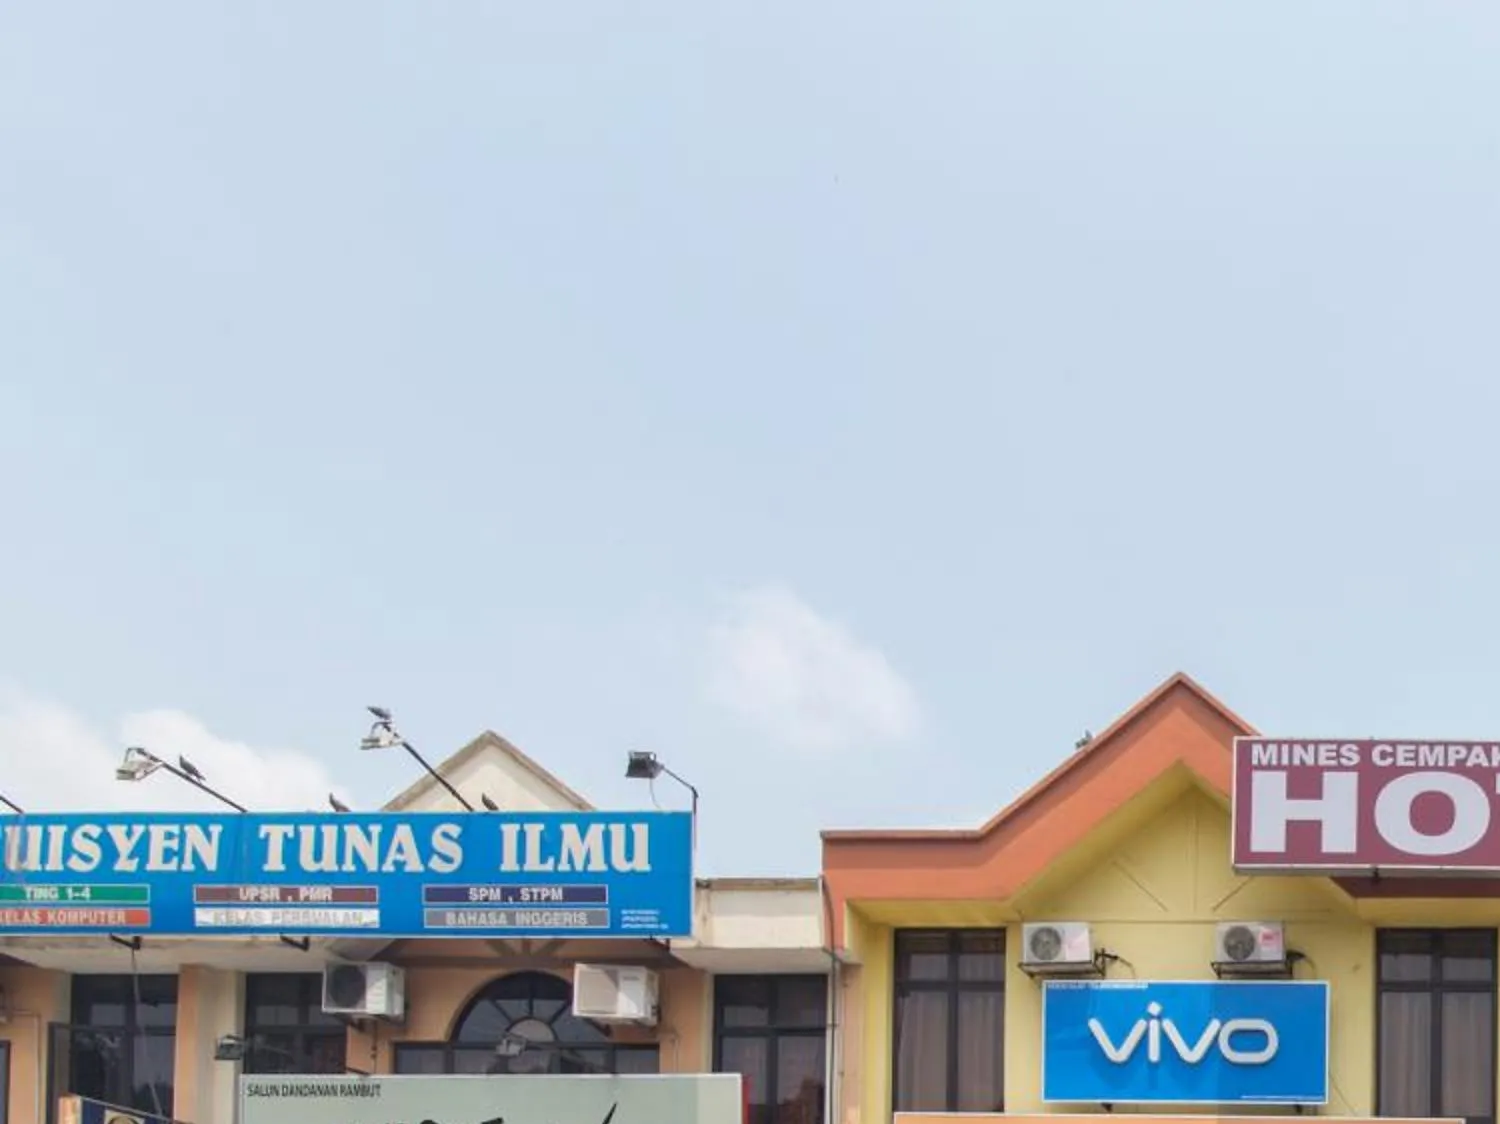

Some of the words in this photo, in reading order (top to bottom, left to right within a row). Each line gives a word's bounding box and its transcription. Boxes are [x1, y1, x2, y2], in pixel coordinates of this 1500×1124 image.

[1250, 743, 1361, 767] MINES
[0, 823, 224, 872] UISYEN
[258, 823, 464, 872] TUNAS
[500, 823, 652, 872] ILMU
[24, 886, 59, 901] TING
[66, 886, 92, 901] 1-4
[238, 886, 281, 901] UPSR
[299, 887, 334, 902] PMR
[468, 887, 501, 901] SPM
[519, 887, 564, 902] STPM
[48, 909, 127, 925] KOMPUTER
[445, 911, 508, 926] BAHASA
[514, 912, 589, 927] INGGERIS
[1087, 1001, 1280, 1063] vivo
